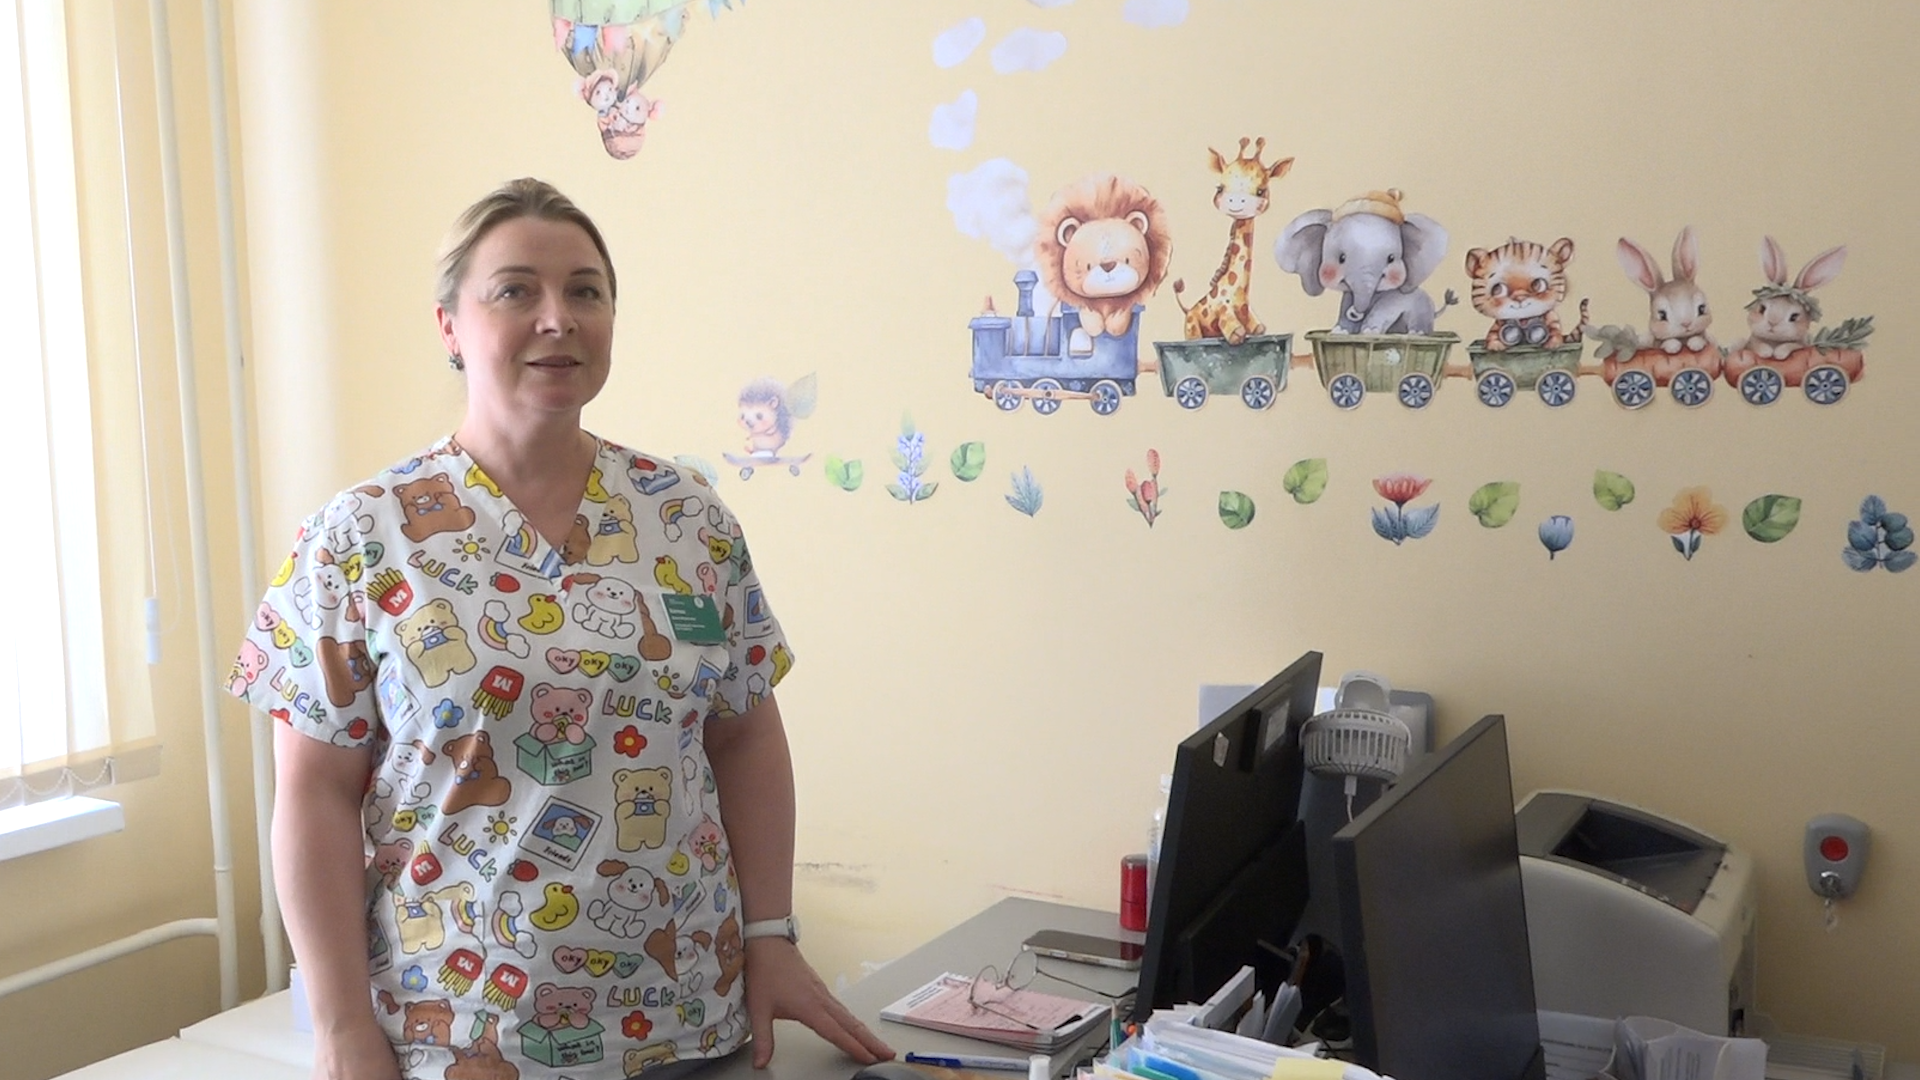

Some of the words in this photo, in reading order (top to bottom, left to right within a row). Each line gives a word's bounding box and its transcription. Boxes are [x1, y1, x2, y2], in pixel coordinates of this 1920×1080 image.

[406, 549, 479, 596] LUCK
[388, 588, 408, 609] M
[491, 674, 514, 693] M
[269, 665, 328, 725] LUCK
[602, 688, 673, 724] LUCK
[438, 822, 498, 883] LUCK
[415, 859, 432, 877] M
[456, 957, 475, 974] M
[499, 970, 520, 988] M
[606, 985, 676, 1008] LUCK
